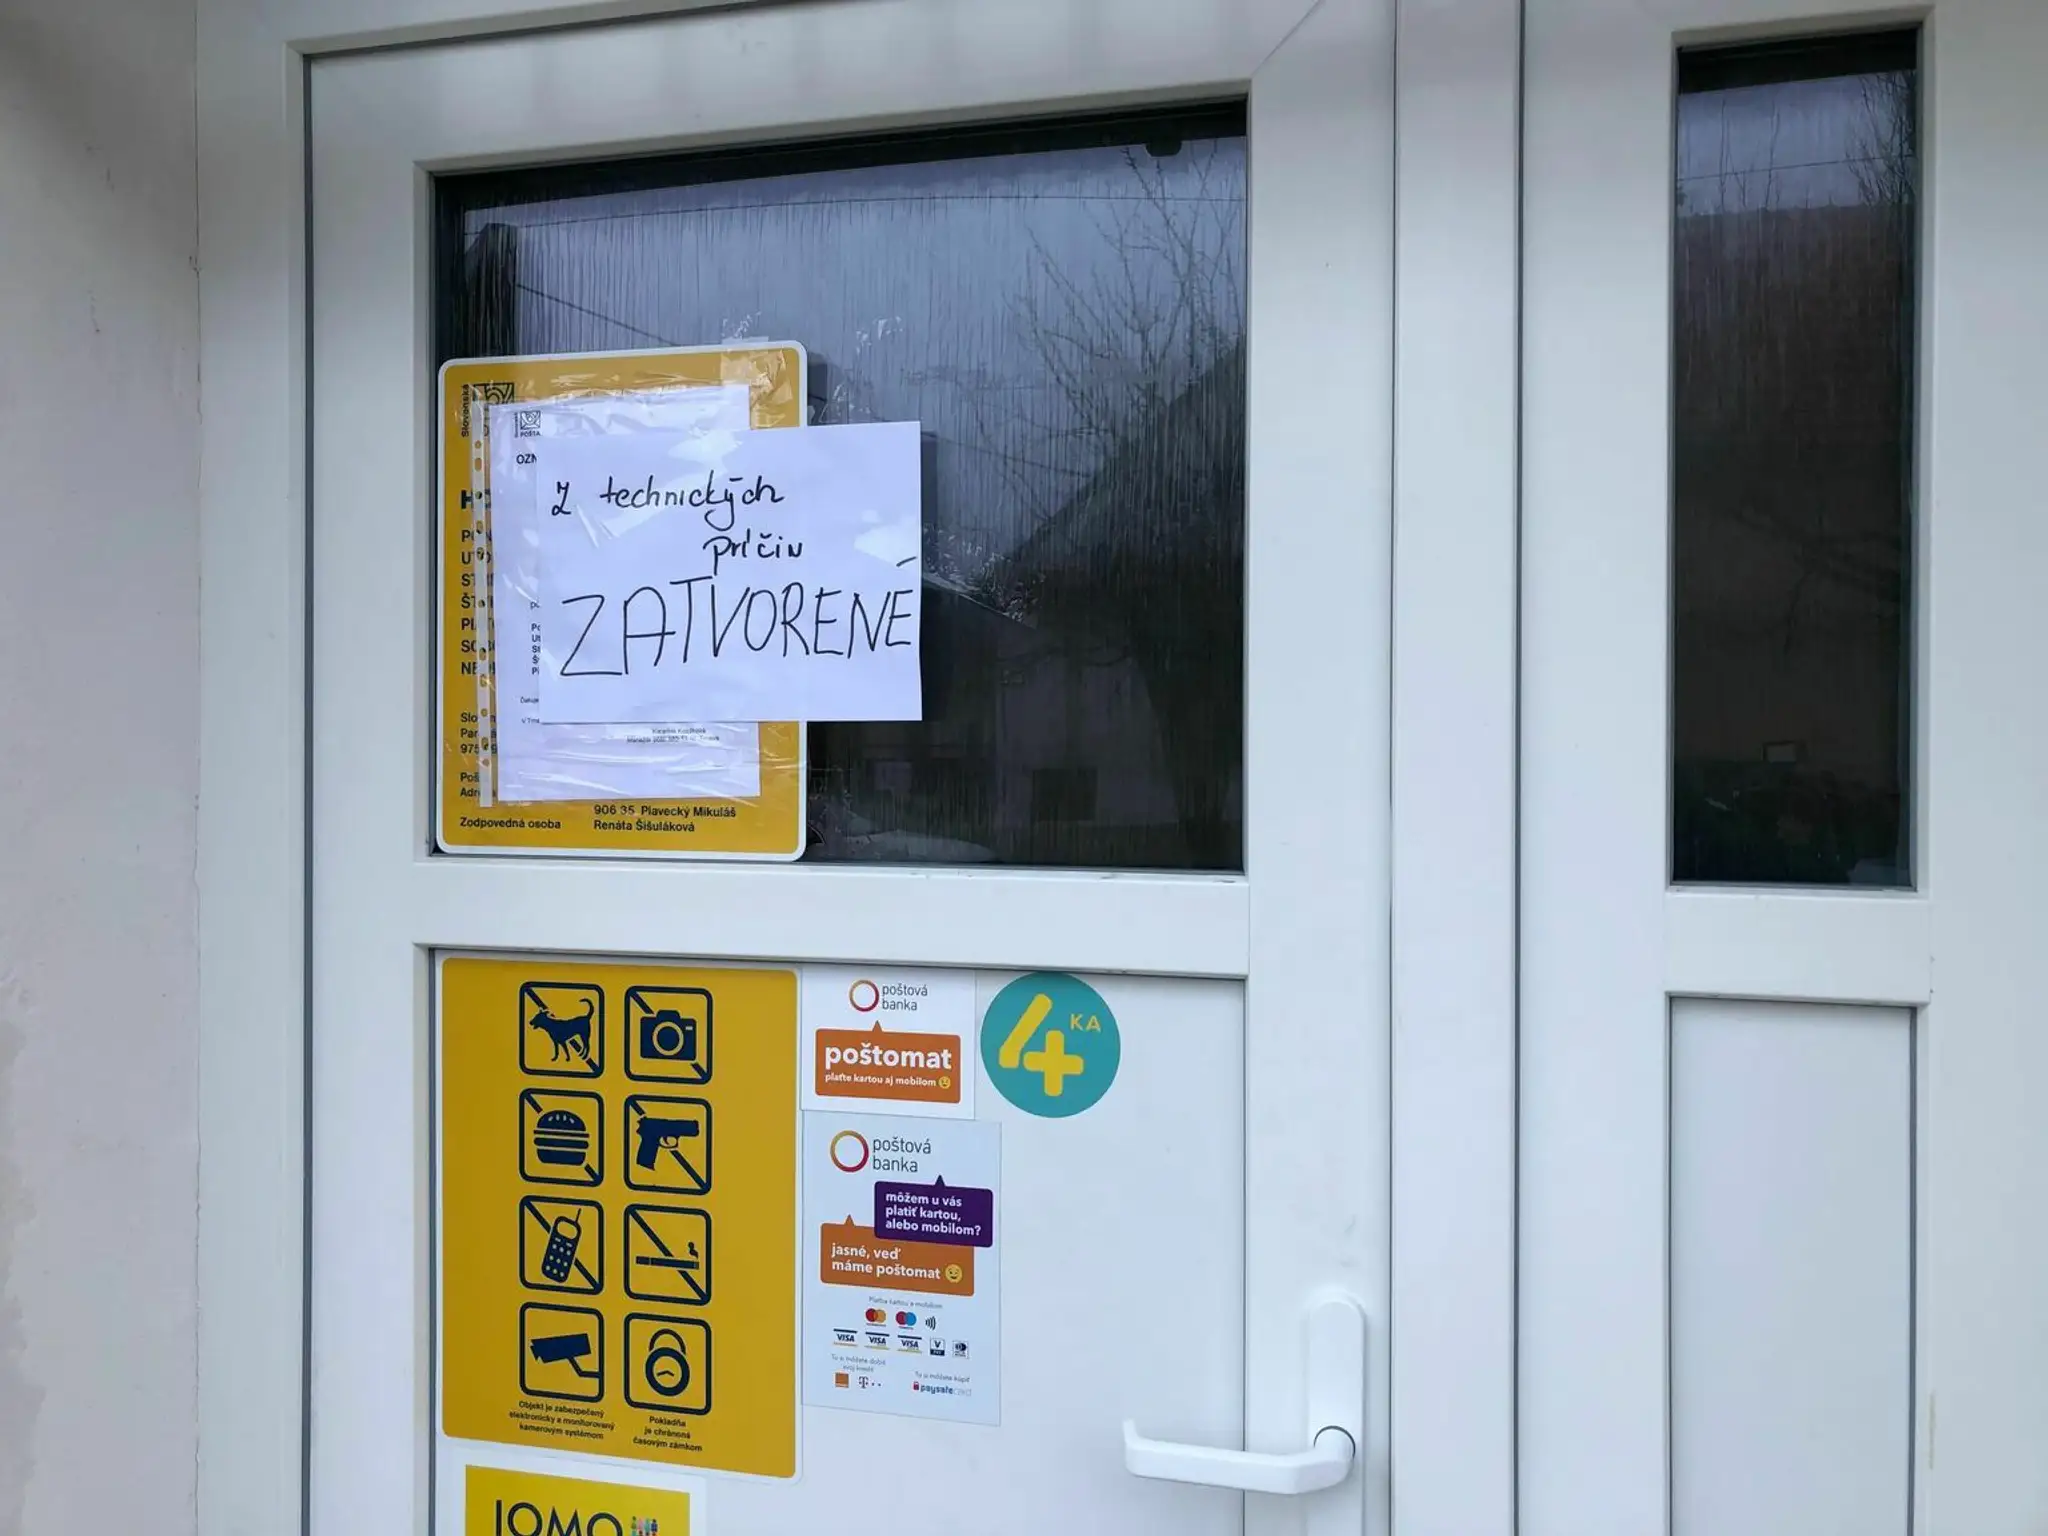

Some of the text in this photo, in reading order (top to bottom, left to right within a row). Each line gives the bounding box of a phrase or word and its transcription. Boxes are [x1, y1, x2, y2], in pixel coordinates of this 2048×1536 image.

[560, 556, 917, 676] ZATVORENÉ
[594, 805, 737, 818] 906 35 Plavecký Mikuláš
[460, 817, 562, 831] Zodpovedná osoba
[594, 819, 695, 832] Renáta Šišuláková
[881, 981, 928, 998] poštová
[881, 998, 918, 1012] banka
[1070, 1014, 1101, 1031] KA
[824, 1042, 952, 1070] poštomat
[853, 1073, 884, 1085] kartou
[885, 1076, 893, 1087] aj
[895, 1076, 936, 1088] mobilom
[873, 1136, 932, 1155] poštová
[873, 1157, 919, 1173] banka
[886, 1192, 962, 1207] môžem u vás
[885, 1204, 961, 1222] platiť kartou,
[885, 1219, 981, 1236] alebo mobilom?
[831, 1242, 901, 1260] jasné, veď
[832, 1258, 941, 1279] máme poštomat
[837, 1333, 919, 1348] VISA VISA VISA
[519, 1401, 604, 1418] Objekt je zabezpečený
[509, 1411, 556, 1424] elektronicky
[519, 1422, 563, 1435] kamerovým
[644, 1426, 652, 1435] je
[633, 1437, 703, 1451] časovým zámkom
